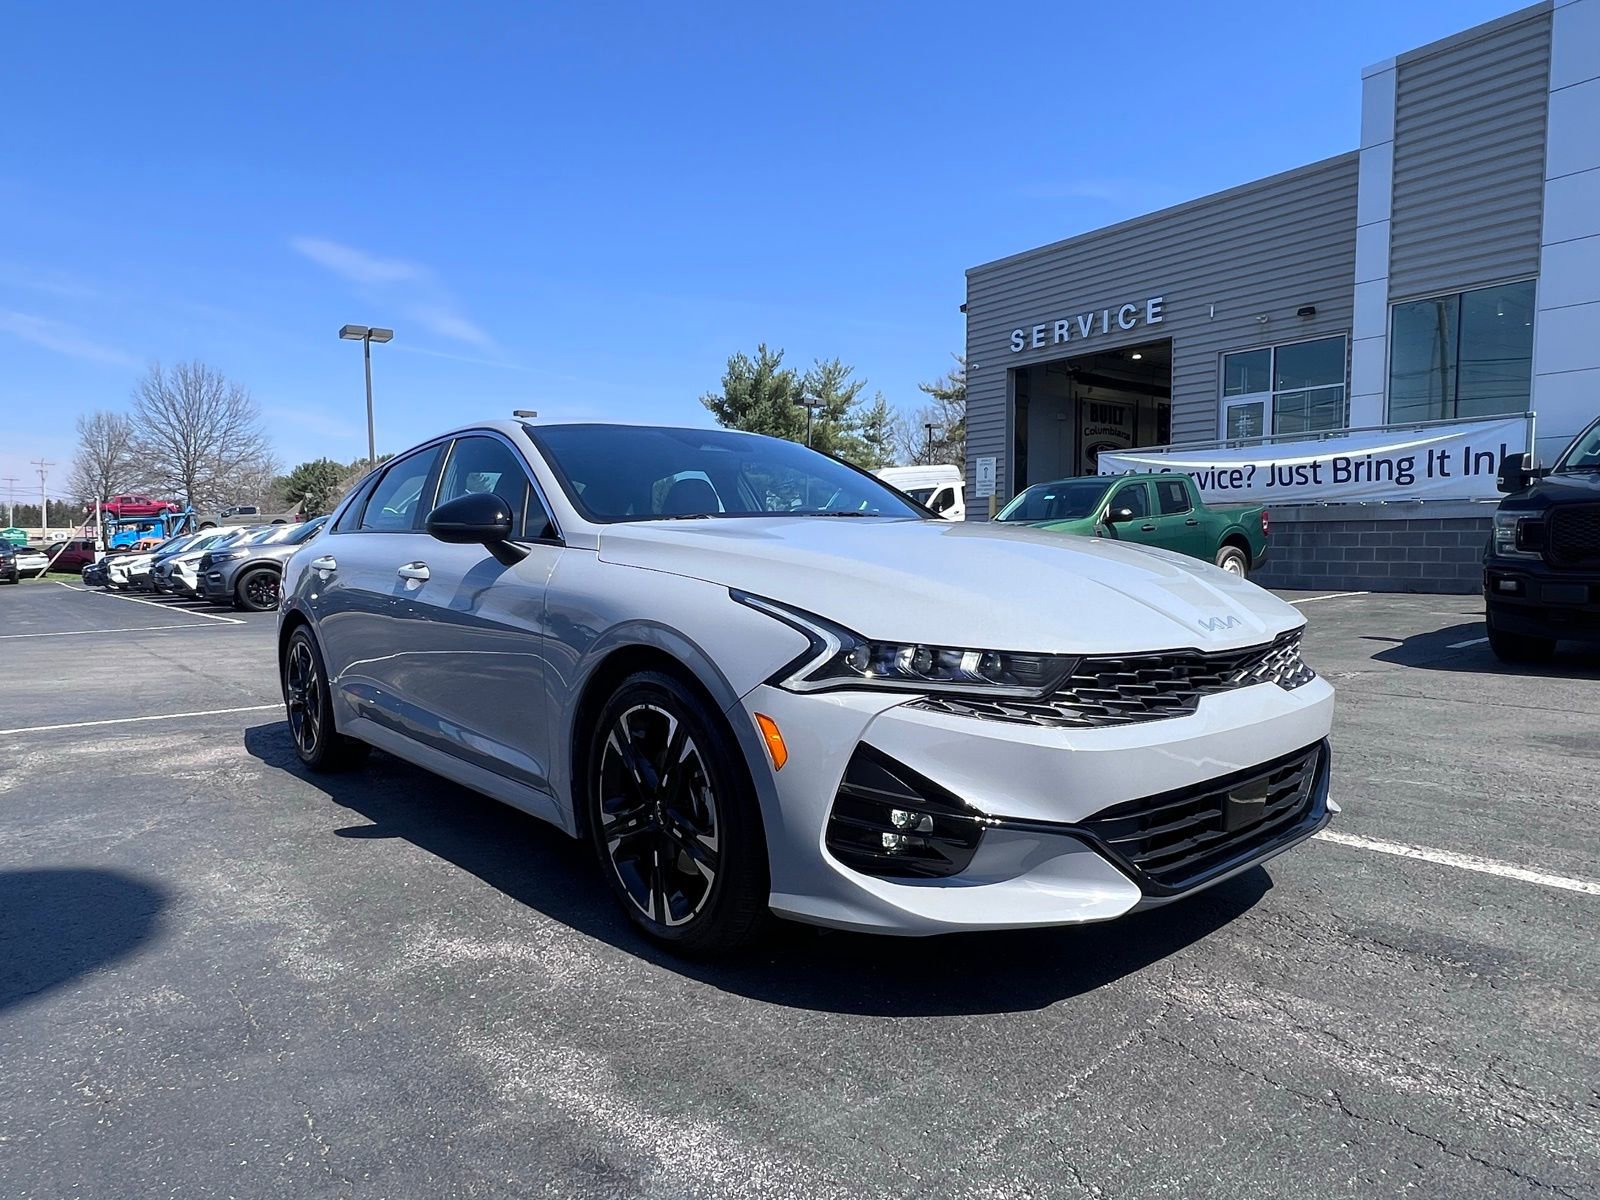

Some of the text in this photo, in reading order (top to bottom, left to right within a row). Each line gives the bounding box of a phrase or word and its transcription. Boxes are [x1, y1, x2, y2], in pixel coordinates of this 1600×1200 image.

[1010, 297, 1164, 353] SERVICE
[1090, 403, 1125, 425] BUILT
[1160, 464, 1256, 490] vice?
[1266, 460, 1322, 487] Just
[1332, 454, 1415, 486] Bring
[1427, 448, 1451, 478] It
